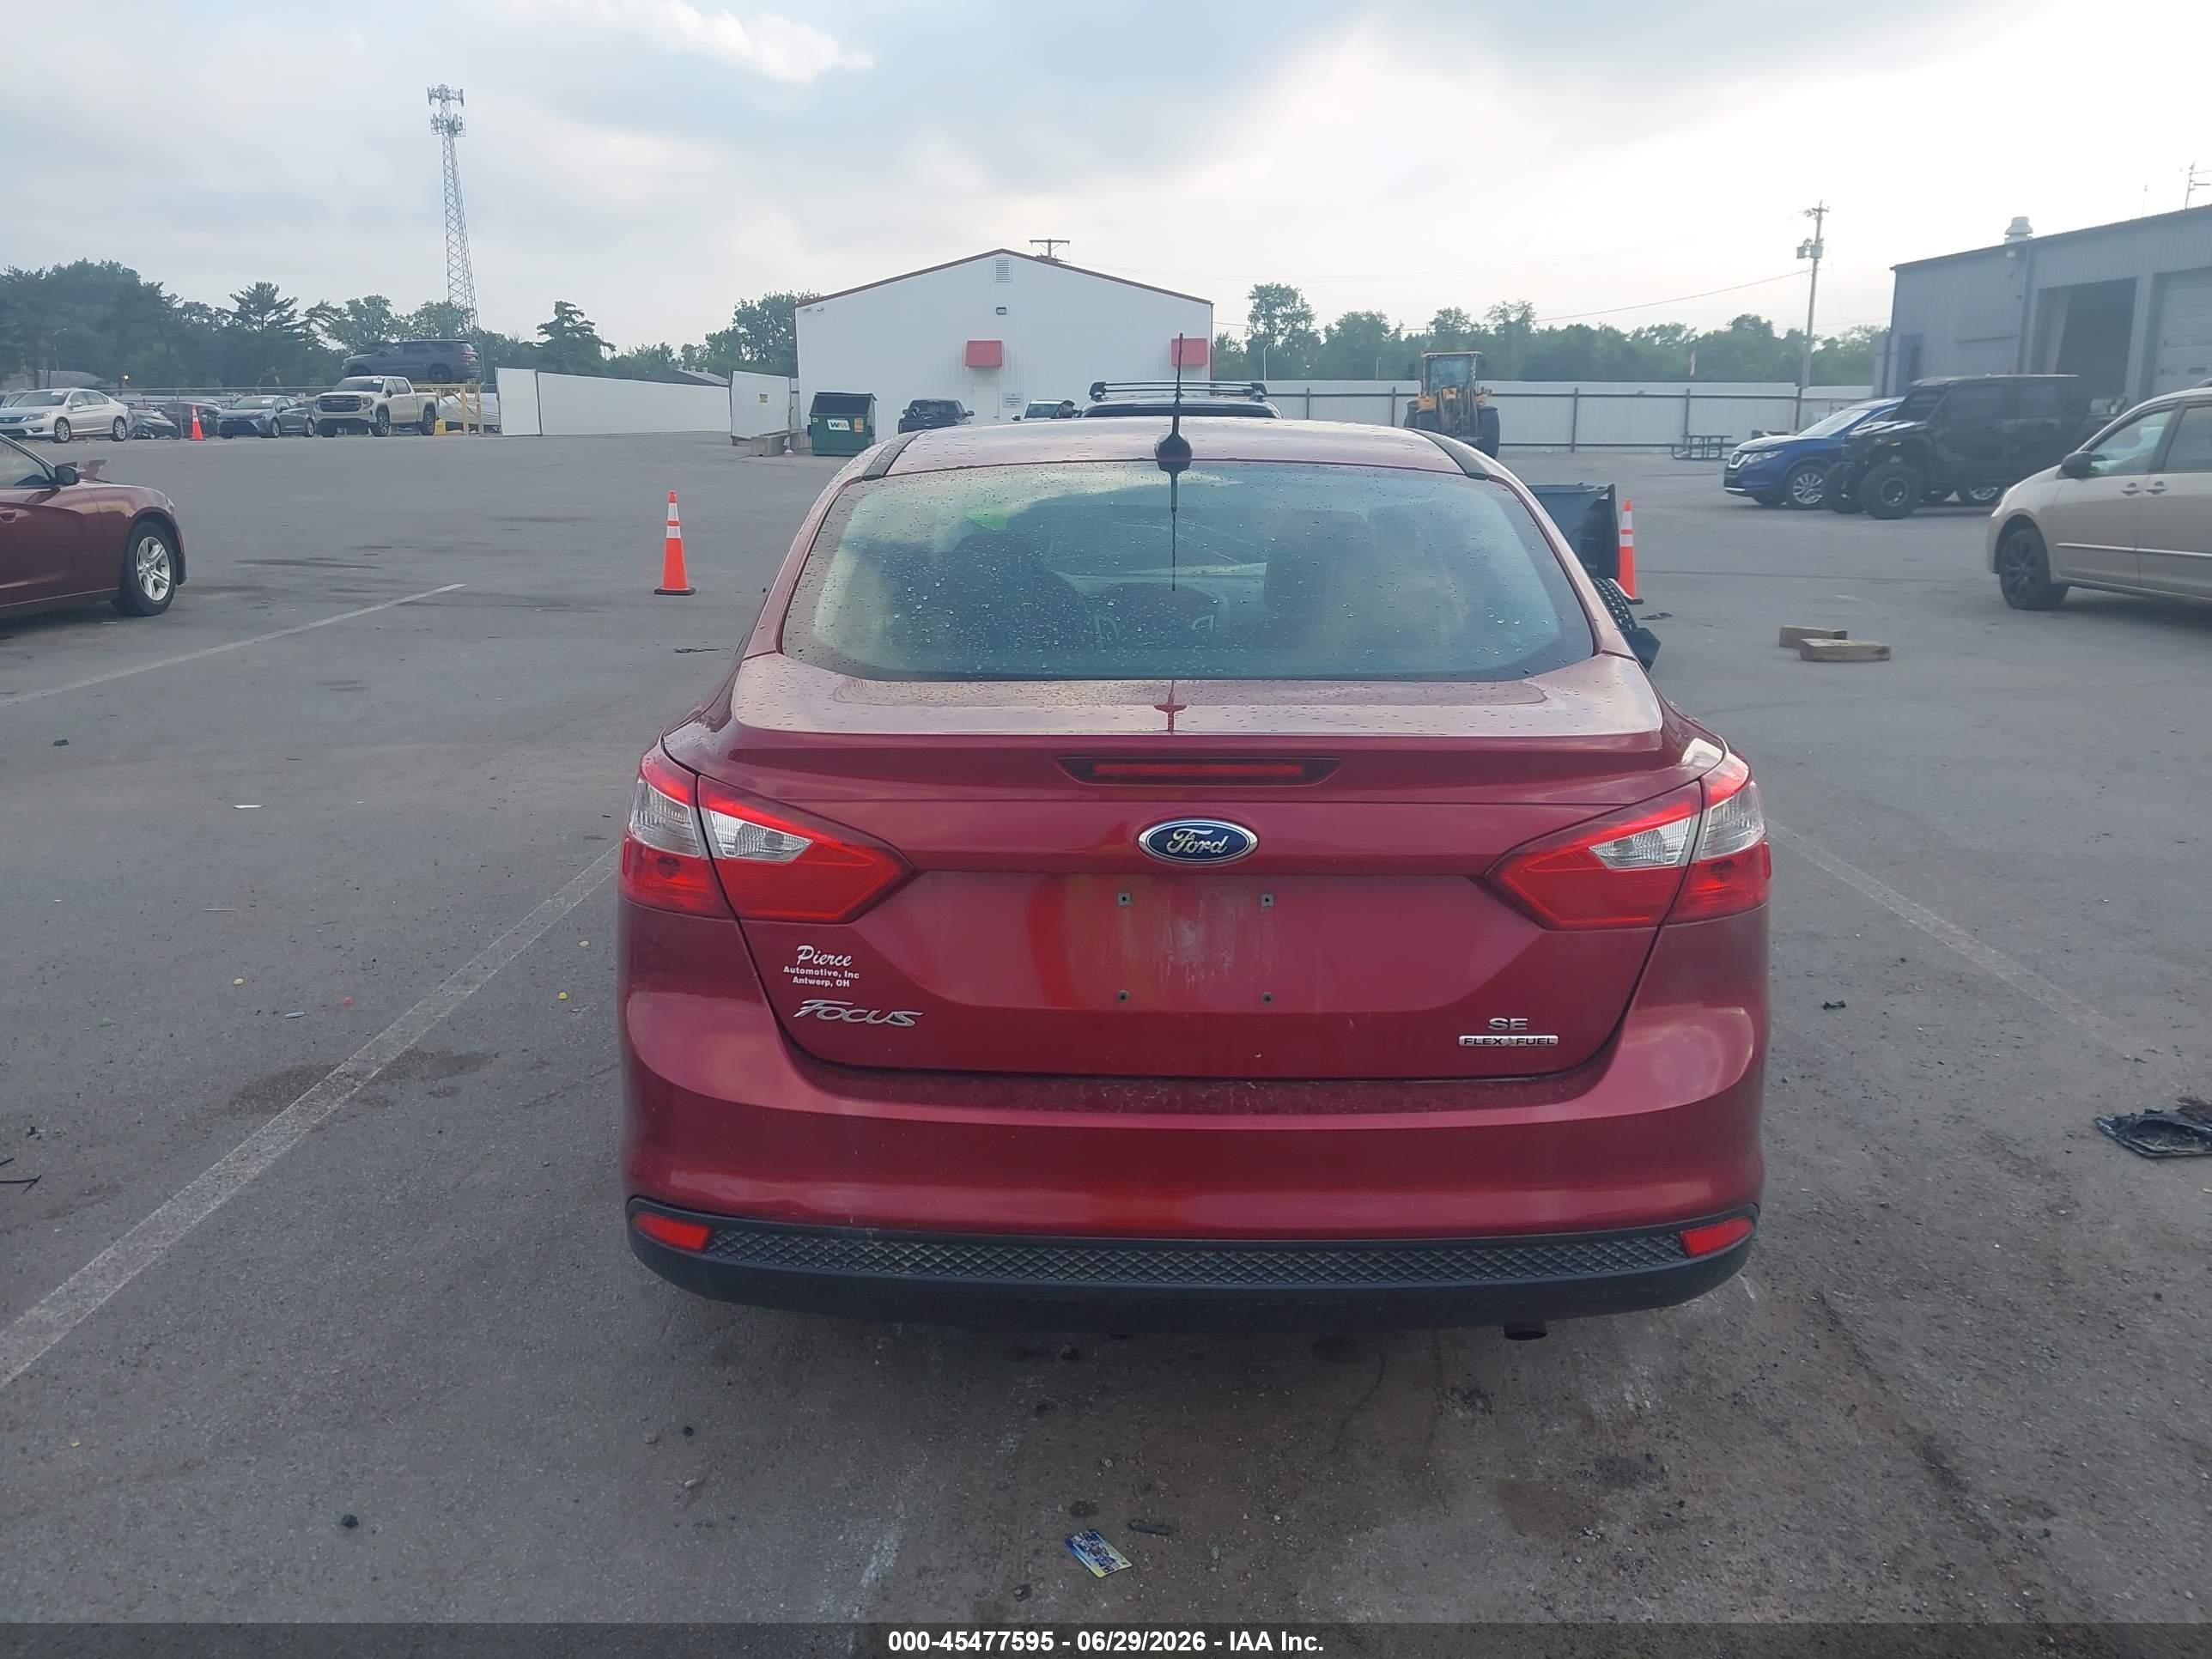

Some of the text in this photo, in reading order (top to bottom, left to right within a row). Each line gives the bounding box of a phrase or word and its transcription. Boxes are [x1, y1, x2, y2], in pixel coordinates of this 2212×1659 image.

[1166, 828, 1229, 854] Ford
[797, 945, 852, 967] Pierce
[783, 965, 860, 979] Automotive, Inc
[793, 975, 850, 988] Antwerp, OH
[1488, 1018, 1528, 1030] SE
[1464, 1037, 1555, 1046] FLEX FUEL
